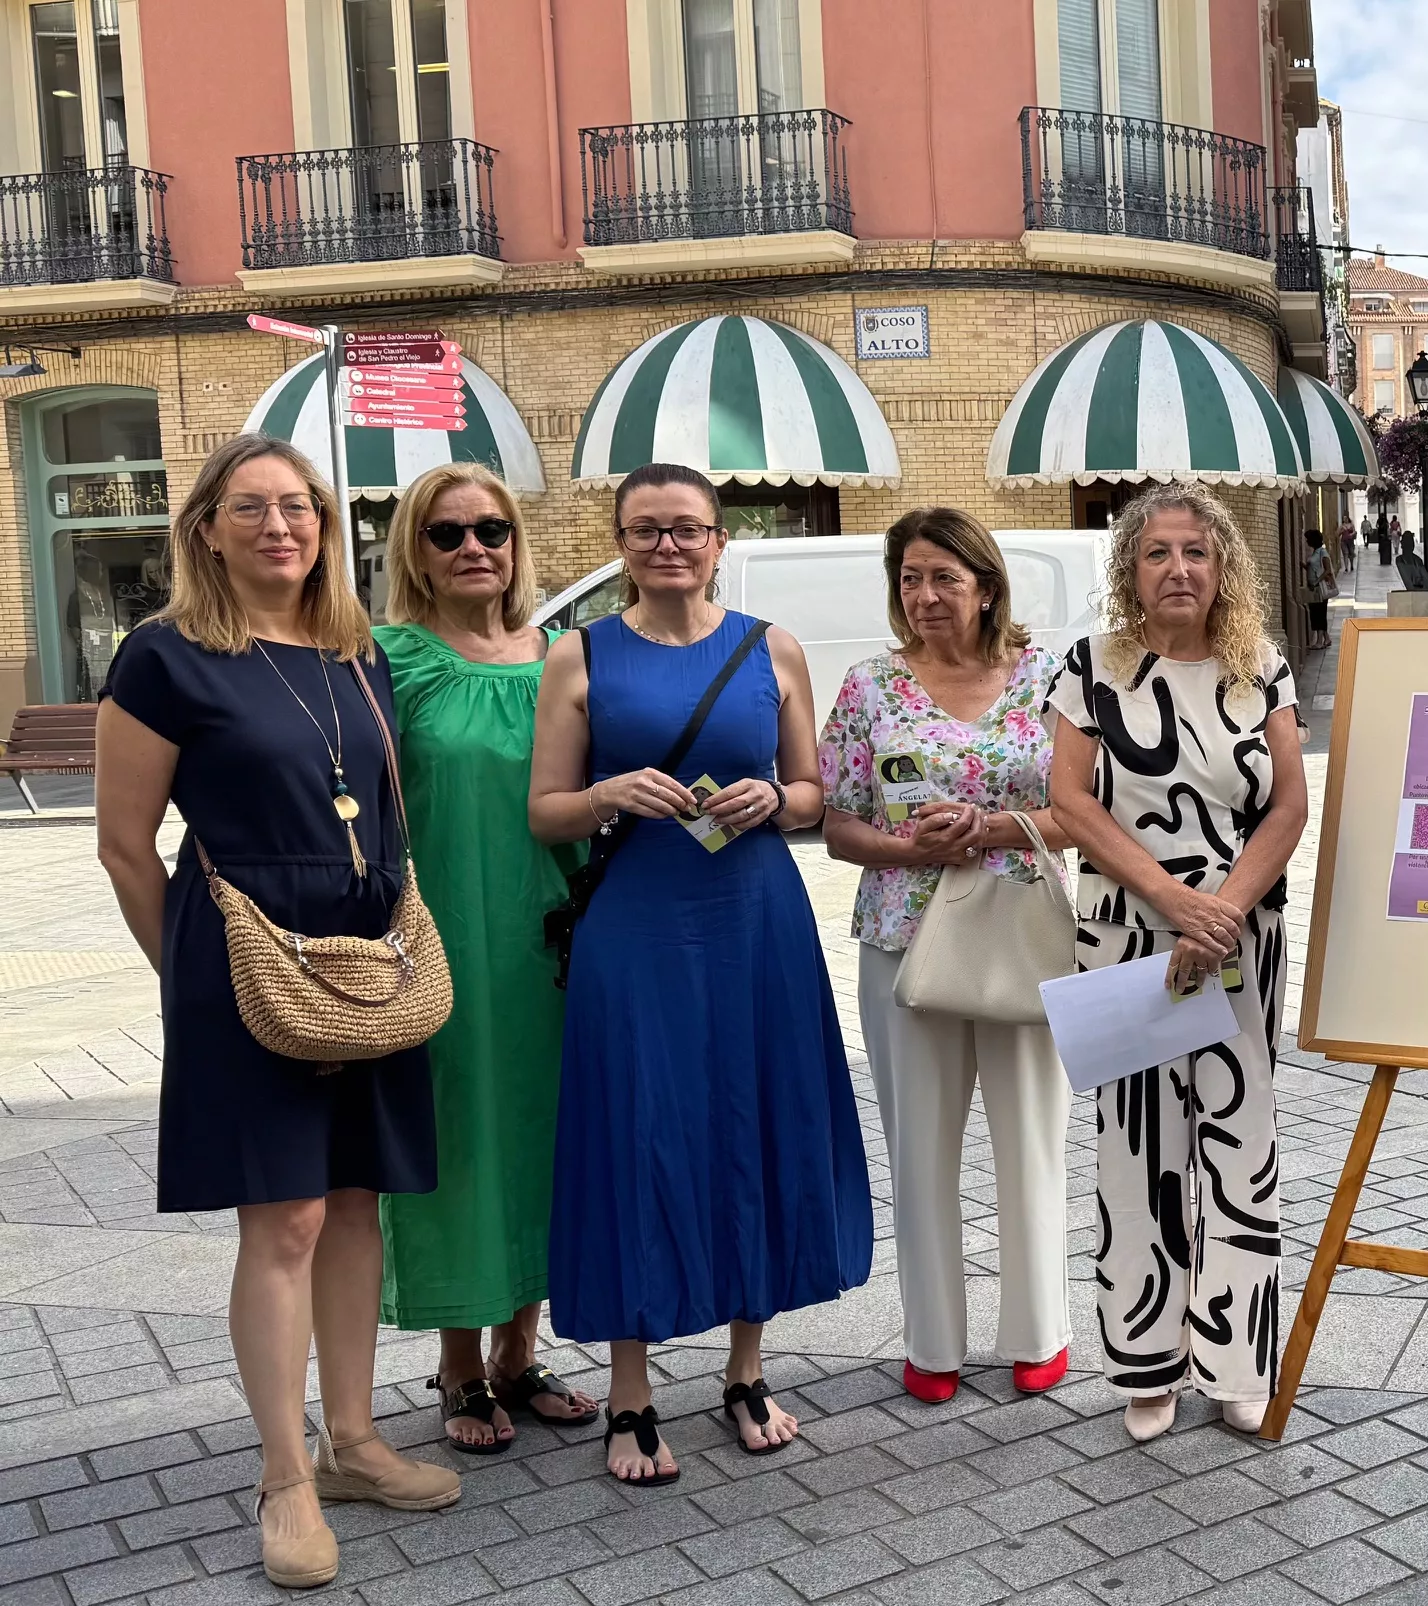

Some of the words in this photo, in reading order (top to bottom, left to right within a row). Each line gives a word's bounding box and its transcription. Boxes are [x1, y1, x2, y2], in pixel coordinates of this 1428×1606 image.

[881, 316, 915, 327] COSO
[867, 338, 919, 351] ALTO
[365, 373, 389, 381] Museo
[390, 374, 426, 384] Diocesano
[366, 387, 395, 396] Catedral
[368, 402, 415, 411] Ayuntamiento
[368, 416, 392, 424] Centro
[393, 417, 424, 426] Histórico
